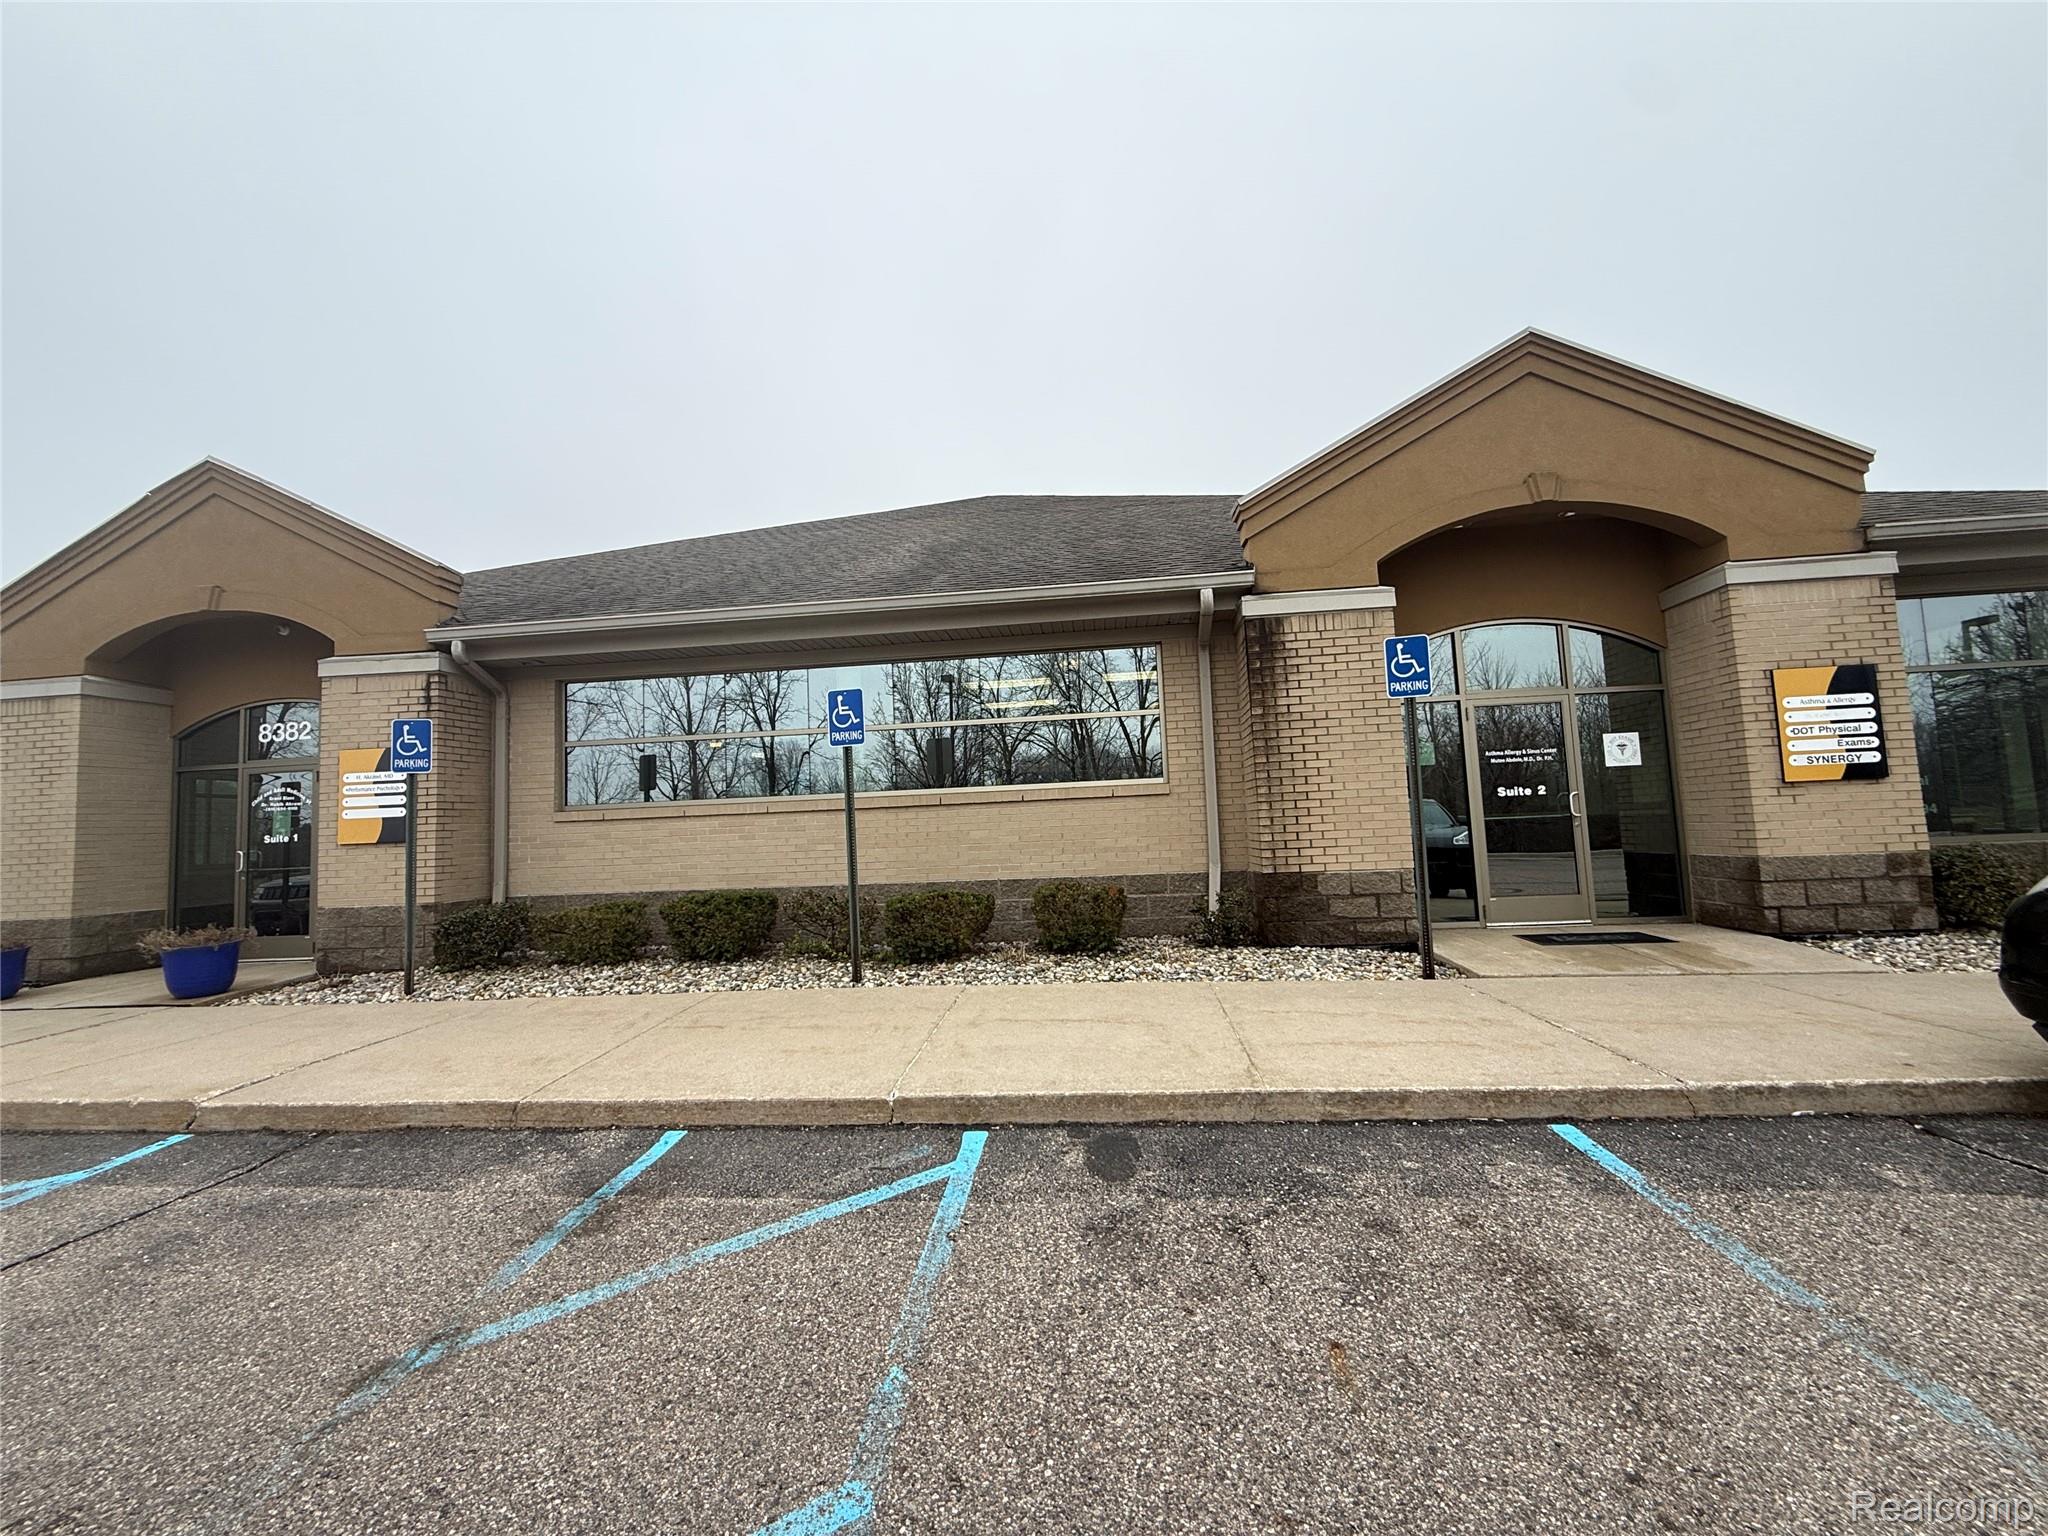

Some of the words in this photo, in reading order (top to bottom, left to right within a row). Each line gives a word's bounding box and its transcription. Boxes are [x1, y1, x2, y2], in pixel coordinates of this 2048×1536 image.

[1390, 680, 1429, 692] PARKING
[258, 720, 312, 743] 8382
[1792, 726, 1815, 735] DOT
[1818, 724, 1862, 735] Physical
[831, 730, 863, 741] PARKING
[1837, 738, 1872, 747] Exams
[394, 758, 429, 768] PARKING
[1806, 753, 1863, 765] SYNERGY
[1497, 785, 1532, 797] Suite
[1537, 784, 1547, 796] 2
[263, 834, 290, 844] Suite
[292, 833, 298, 842] 1
